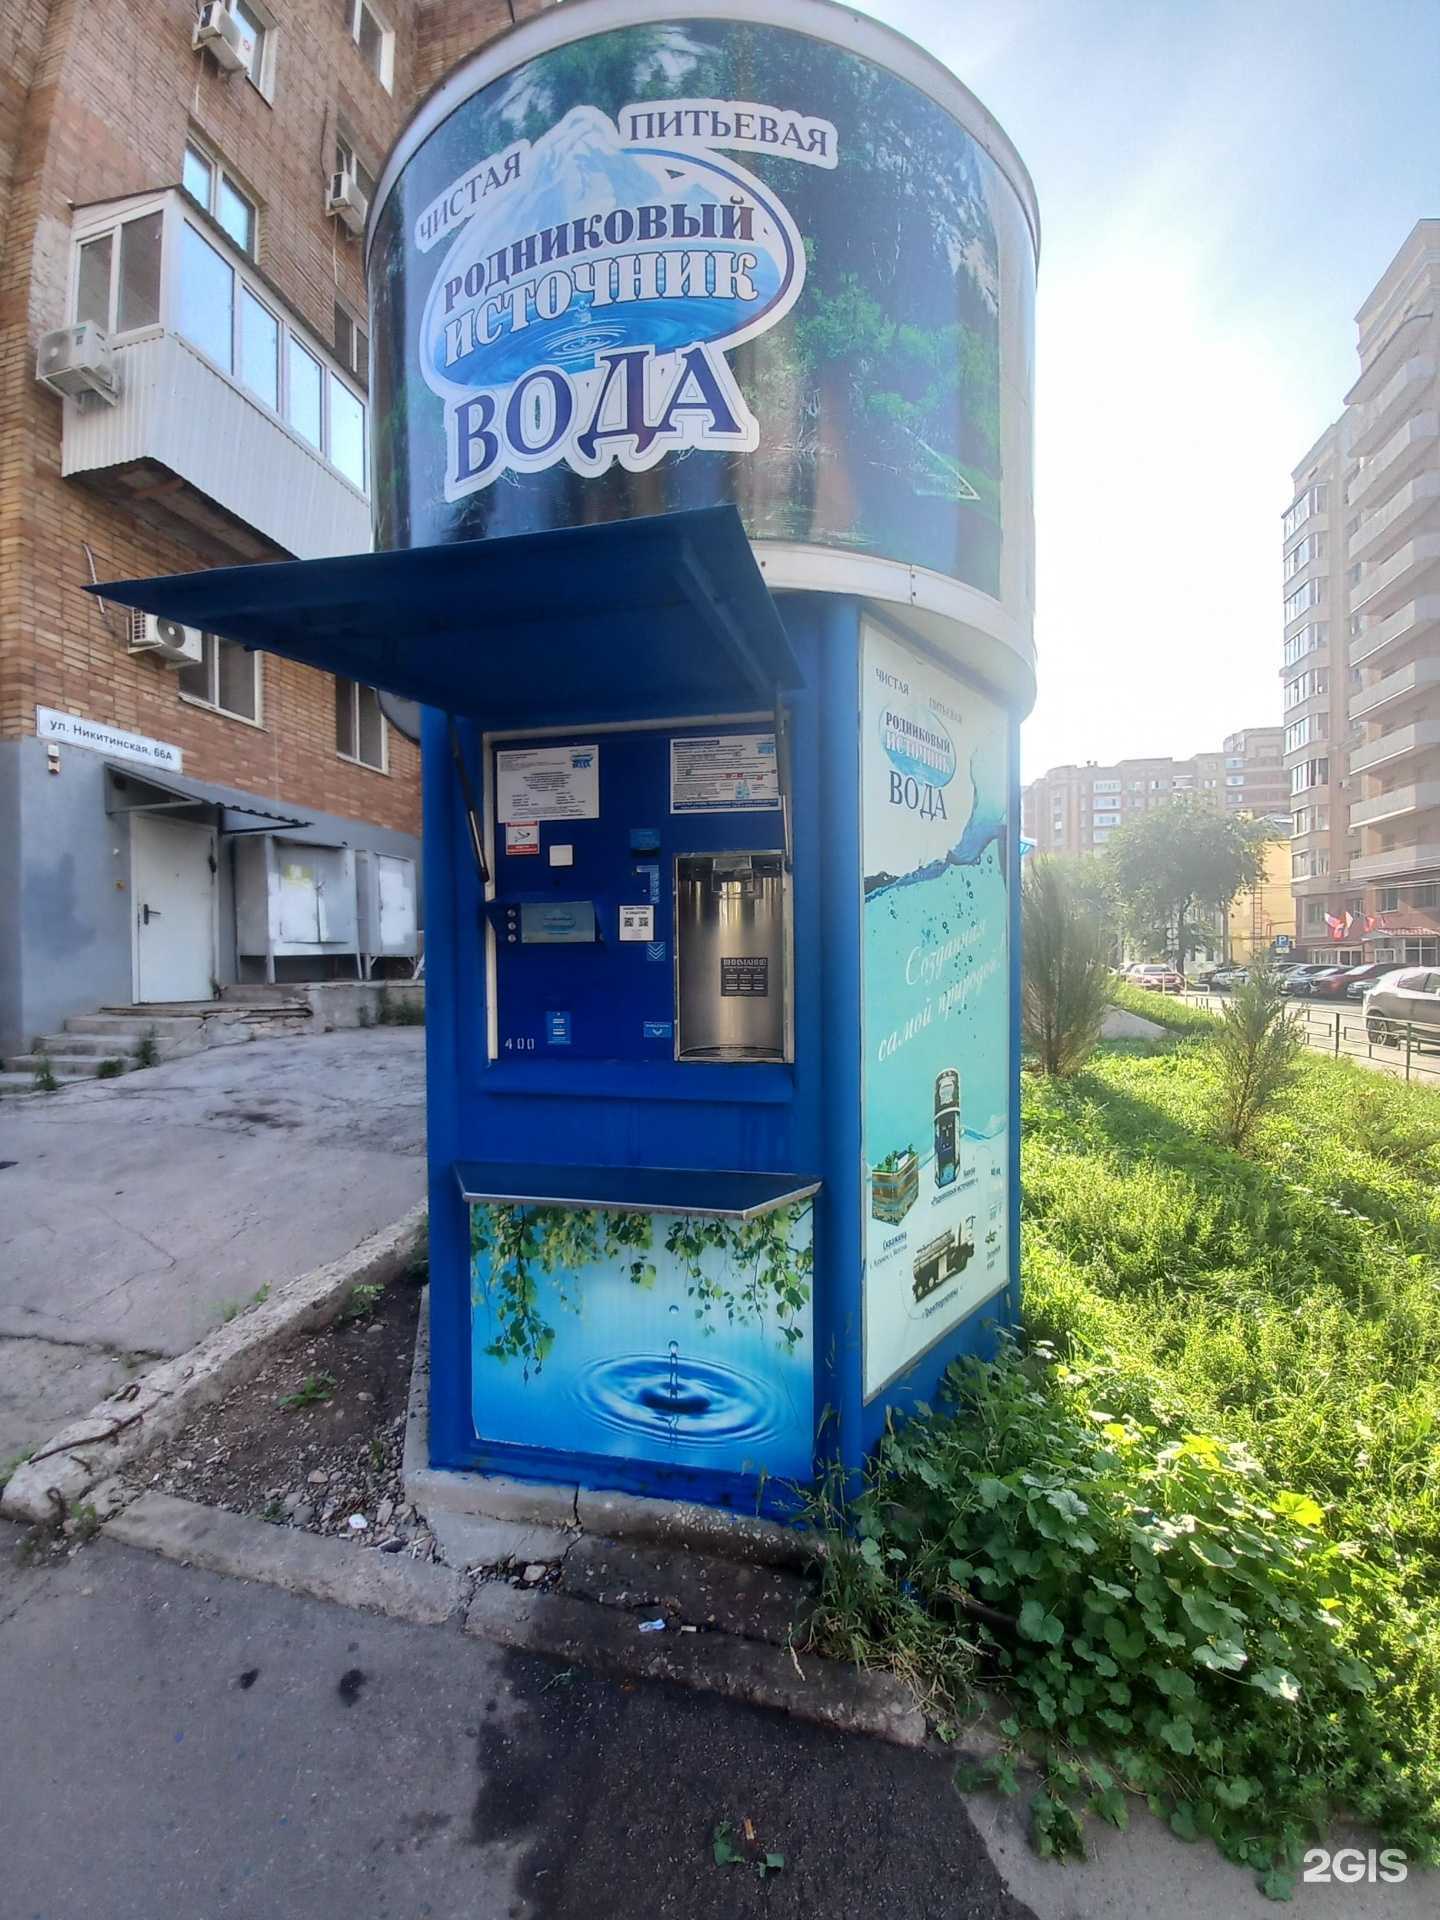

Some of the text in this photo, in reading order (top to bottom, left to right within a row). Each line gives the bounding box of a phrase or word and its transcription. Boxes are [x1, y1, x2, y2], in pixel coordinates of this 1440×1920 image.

[630, 110, 828, 157] ПИТЬЕВАЯ
[420, 152, 521, 239] ЧИСТАЯ
[444, 196, 754, 314] РОДНИКОВЫЙ
[444, 249, 759, 368] ИСТОЧНИК
[454, 348, 743, 483] ВОДА
[875, 667, 910, 696] ЧИСТАЯ
[50, 719, 70, 732] ул.
[153, 747, 173, 761] 66А
[886, 711, 951, 754] РОДНИКОВЫЙ
[889, 770, 948, 821] ВОДА
